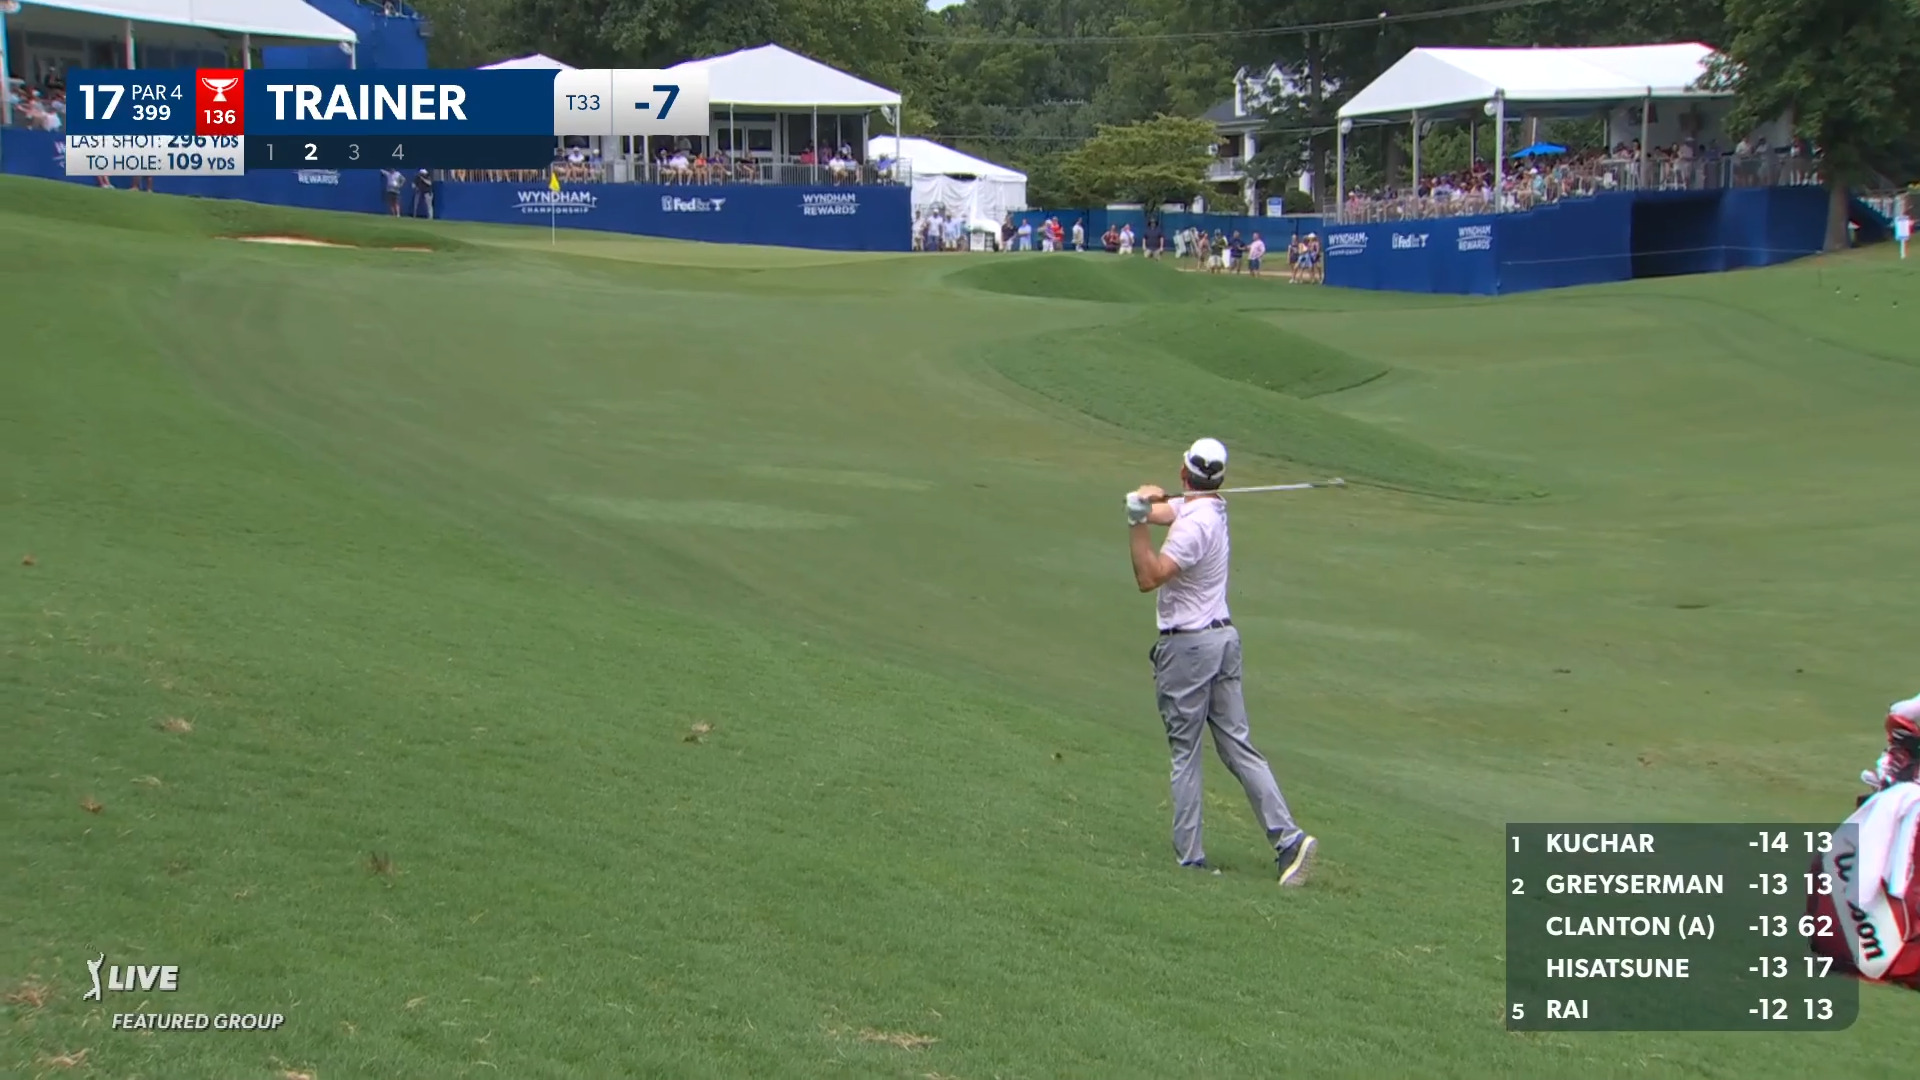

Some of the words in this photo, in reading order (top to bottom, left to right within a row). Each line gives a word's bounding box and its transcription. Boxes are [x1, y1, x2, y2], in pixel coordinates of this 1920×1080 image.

[517, 190, 591, 203] WYNDHAM
[802, 193, 856, 203] WYNDHAM
[521, 206, 589, 214] CHAMPIONSHIP
[803, 205, 856, 216] REWARDS
[1458, 224, 1492, 237] WYNDHAM
[1328, 232, 1366, 246] WYNDHAM
[1458, 239, 1491, 251] REWARDS
[1834, 838, 1884, 961] Wson
